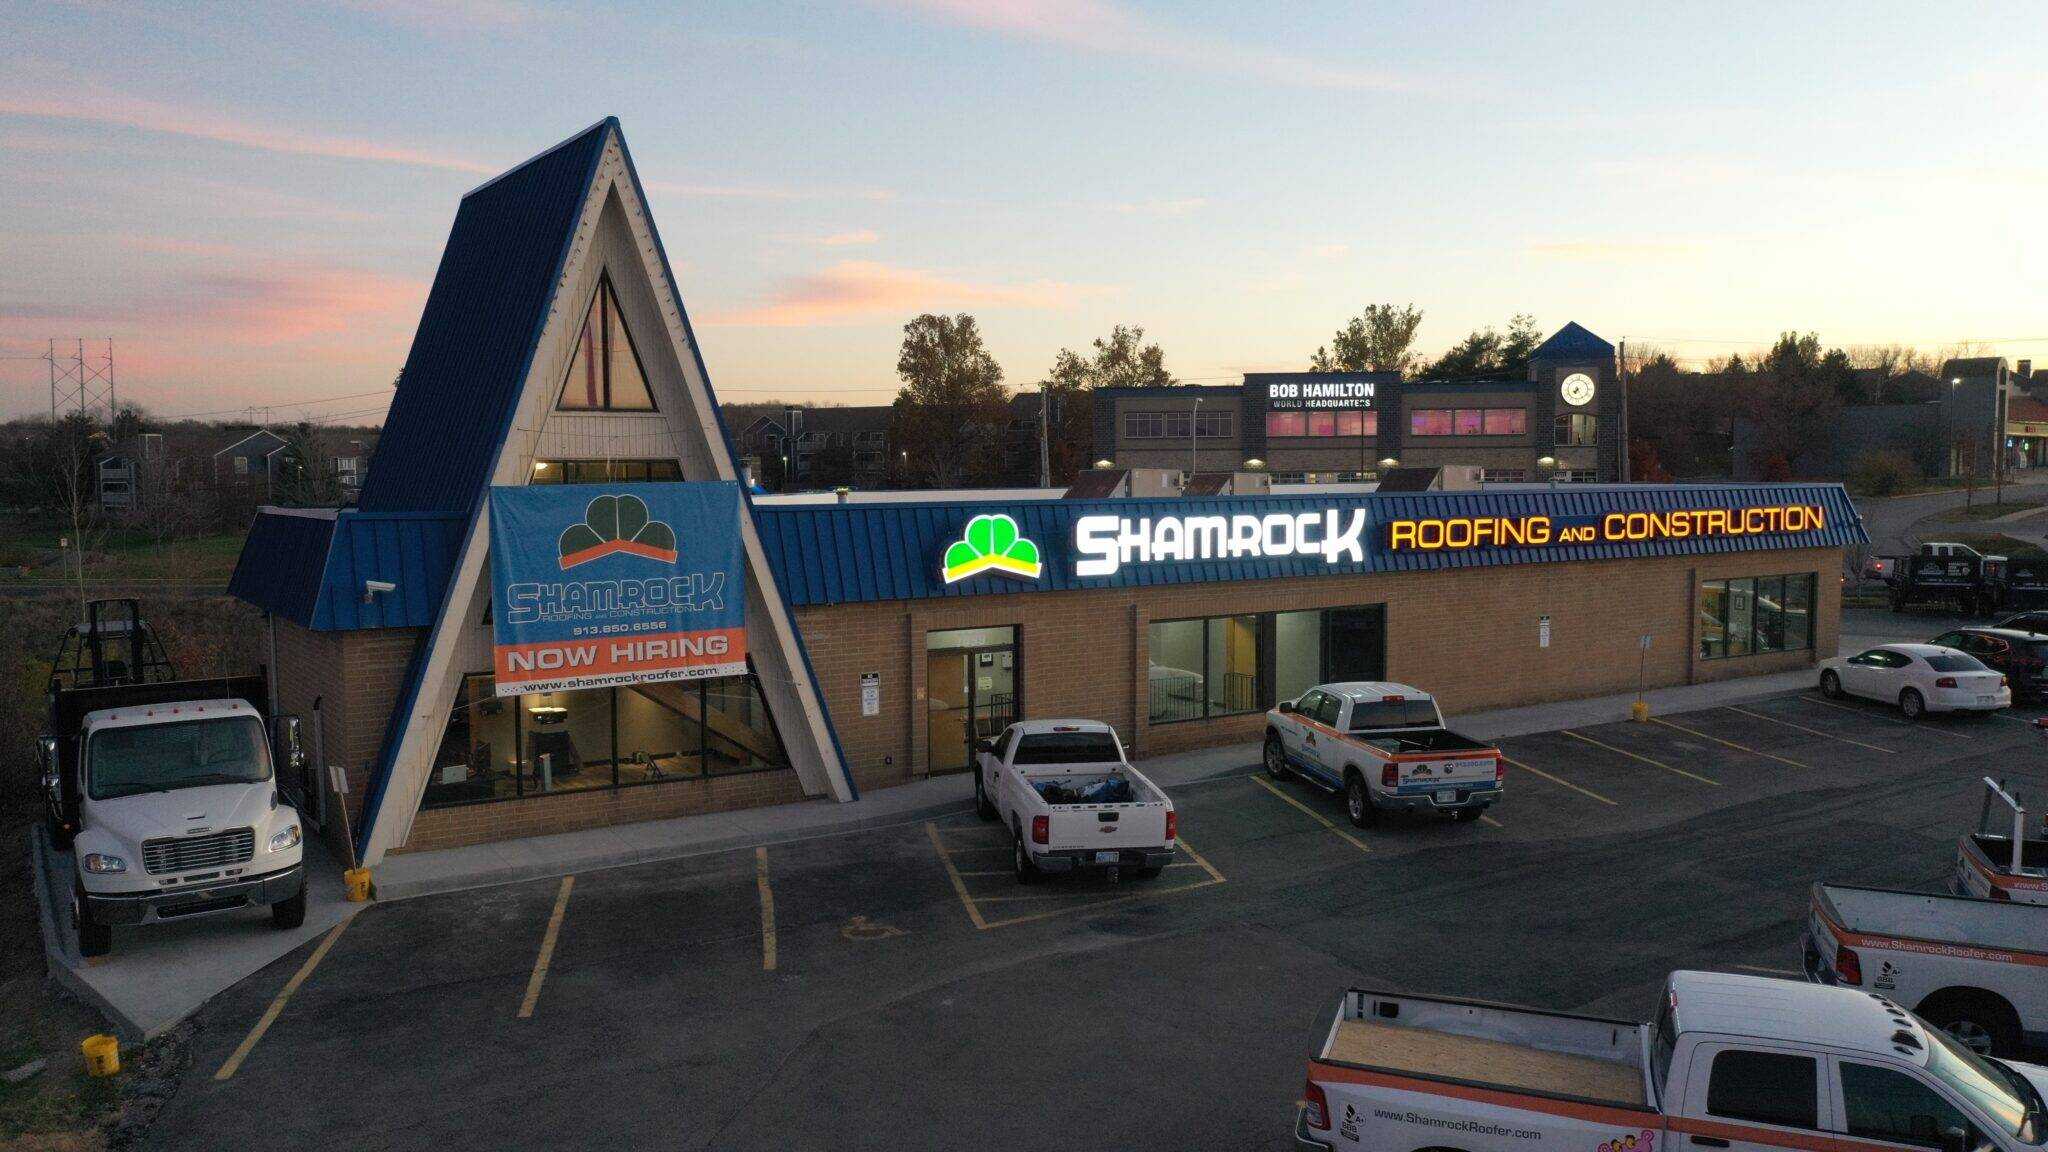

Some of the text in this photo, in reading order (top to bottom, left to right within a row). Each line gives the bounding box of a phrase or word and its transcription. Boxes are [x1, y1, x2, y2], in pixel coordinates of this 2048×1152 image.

[1269, 383, 1374, 398] BOB HAMILTON
[1273, 400, 1302, 408] WORLD
[1391, 506, 1825, 550] ROOFING AND CONSTRUCTION
[1076, 508, 1366, 577] SHAMROCK
[508, 572, 725, 624] SHAMROCK
[540, 613, 592, 622] ROOFING
[609, 605, 693, 618] CONSTRUCTION
[573, 621, 667, 636] 913.850.6556
[508, 635, 729, 673] NOW HIRING
[524, 666, 718, 692] www.shamrockroofer.com
[1861, 938, 2013, 963] www.ShamrockRoofer.com
[1374, 1108, 1541, 1140] www.ShamrockRoofer.com
